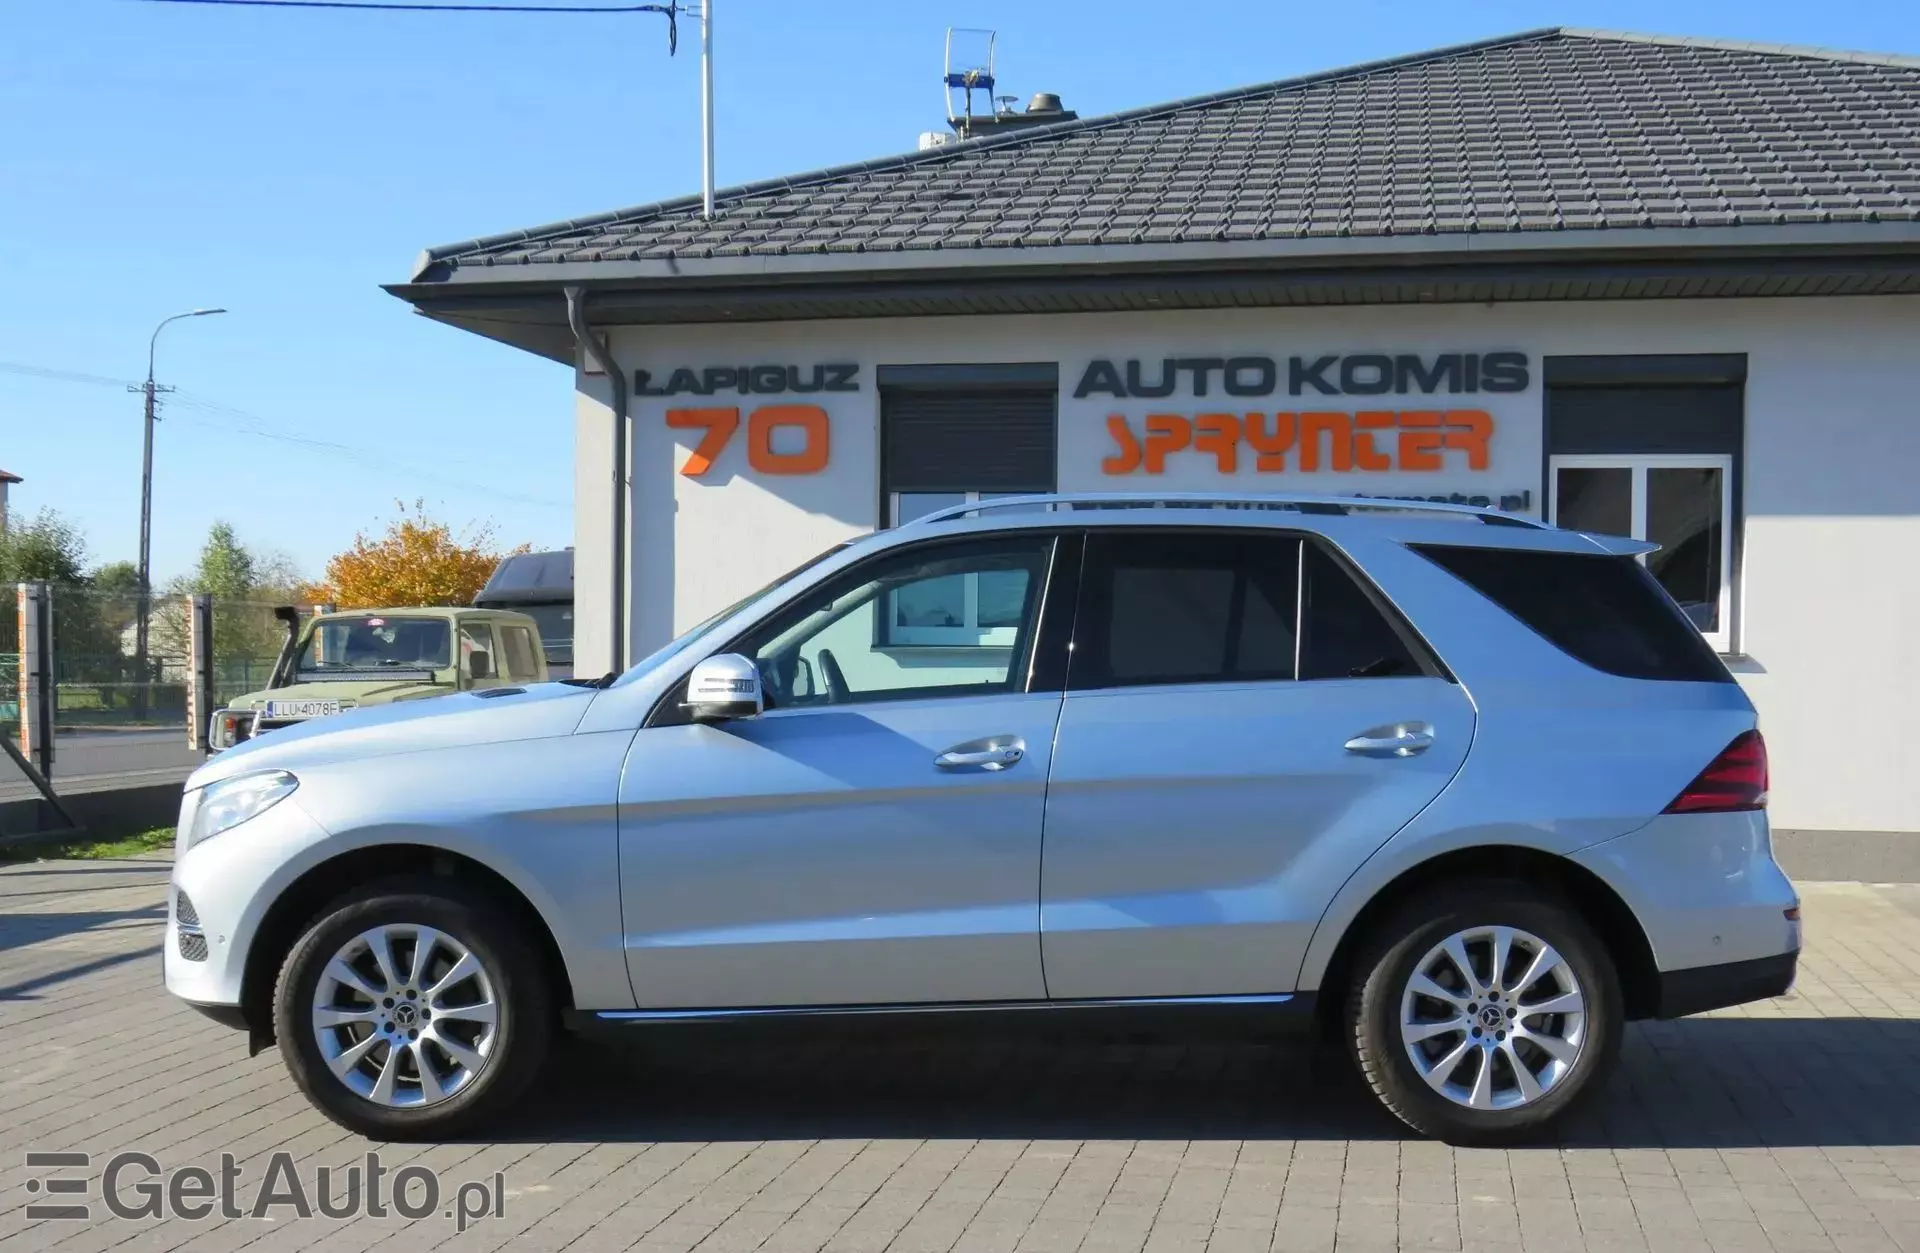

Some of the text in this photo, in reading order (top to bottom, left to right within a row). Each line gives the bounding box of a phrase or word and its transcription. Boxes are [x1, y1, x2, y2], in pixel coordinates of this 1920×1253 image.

[1072, 351, 1530, 400] AUTO KOMIS
[664, 404, 830, 477] 70
[1103, 409, 1494, 475] SPRYNTER
[274, 703, 298, 716] LLU
